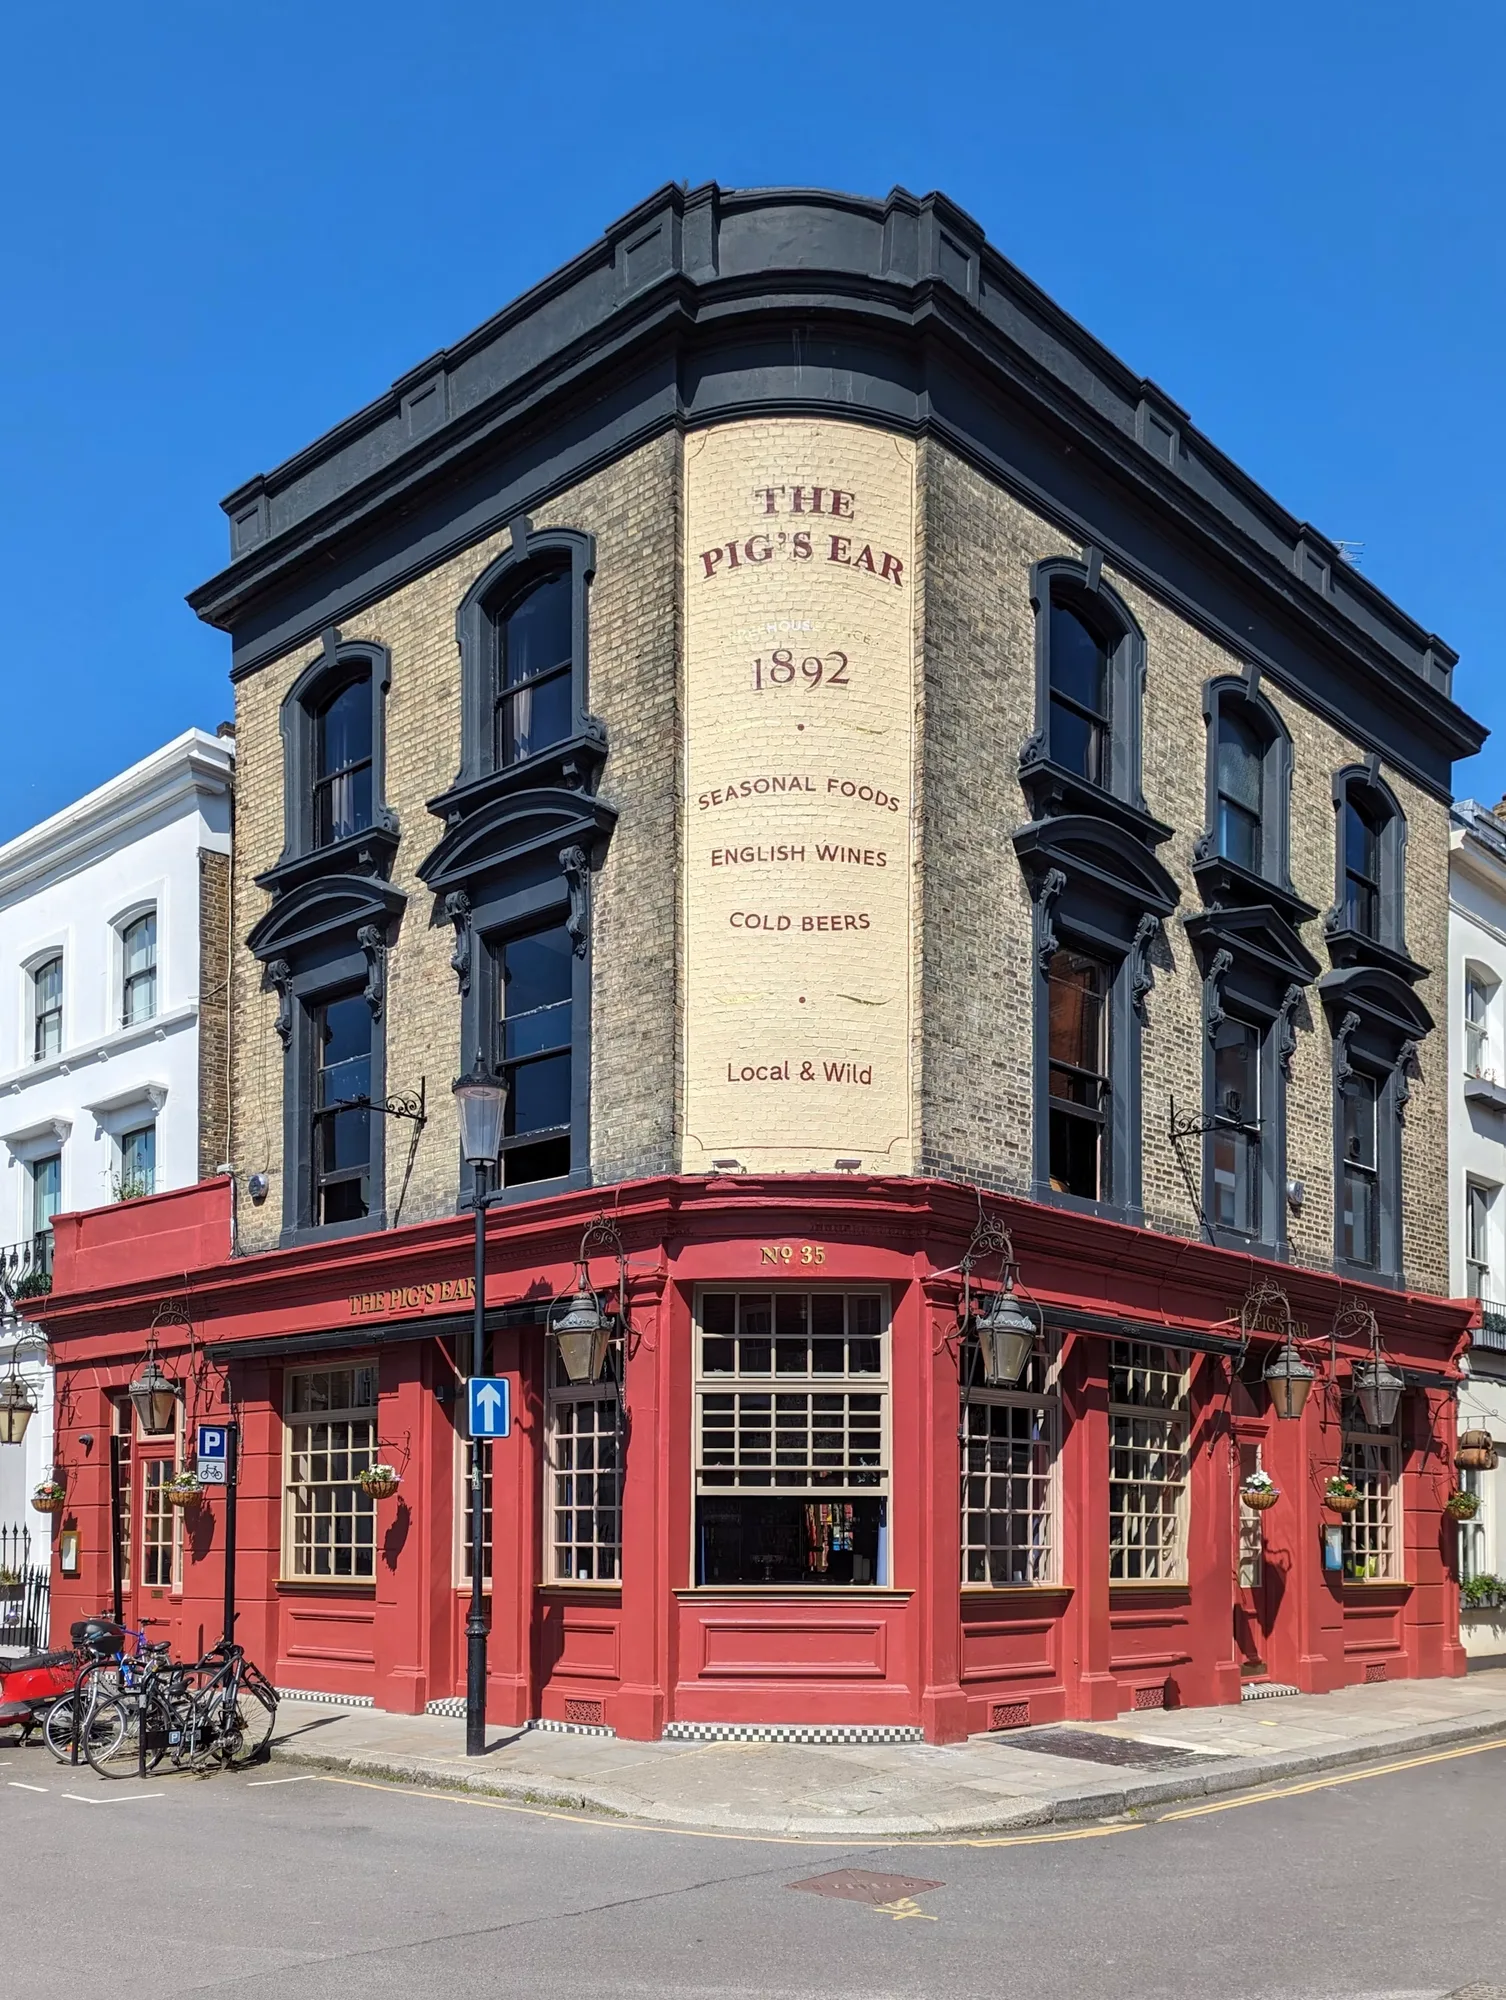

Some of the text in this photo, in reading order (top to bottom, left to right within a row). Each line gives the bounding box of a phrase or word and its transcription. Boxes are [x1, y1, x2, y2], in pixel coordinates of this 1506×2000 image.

[755, 486, 855, 521] THE
[699, 532, 903, 588] PIG'S EAR
[754, 649, 850, 691] 1892
[698, 777, 900, 812] SEASONAL FOODS
[711, 844, 887, 867] ENGLISH WINES
[729, 911, 870, 931] COLD BEERS
[727, 1060, 872, 1085] Local & Wild
[801, 1245, 825, 1265] 35
[348, 1290, 385, 1315] THE
[389, 1282, 435, 1310] PIG'S
[205, 1431, 221, 1455] P
